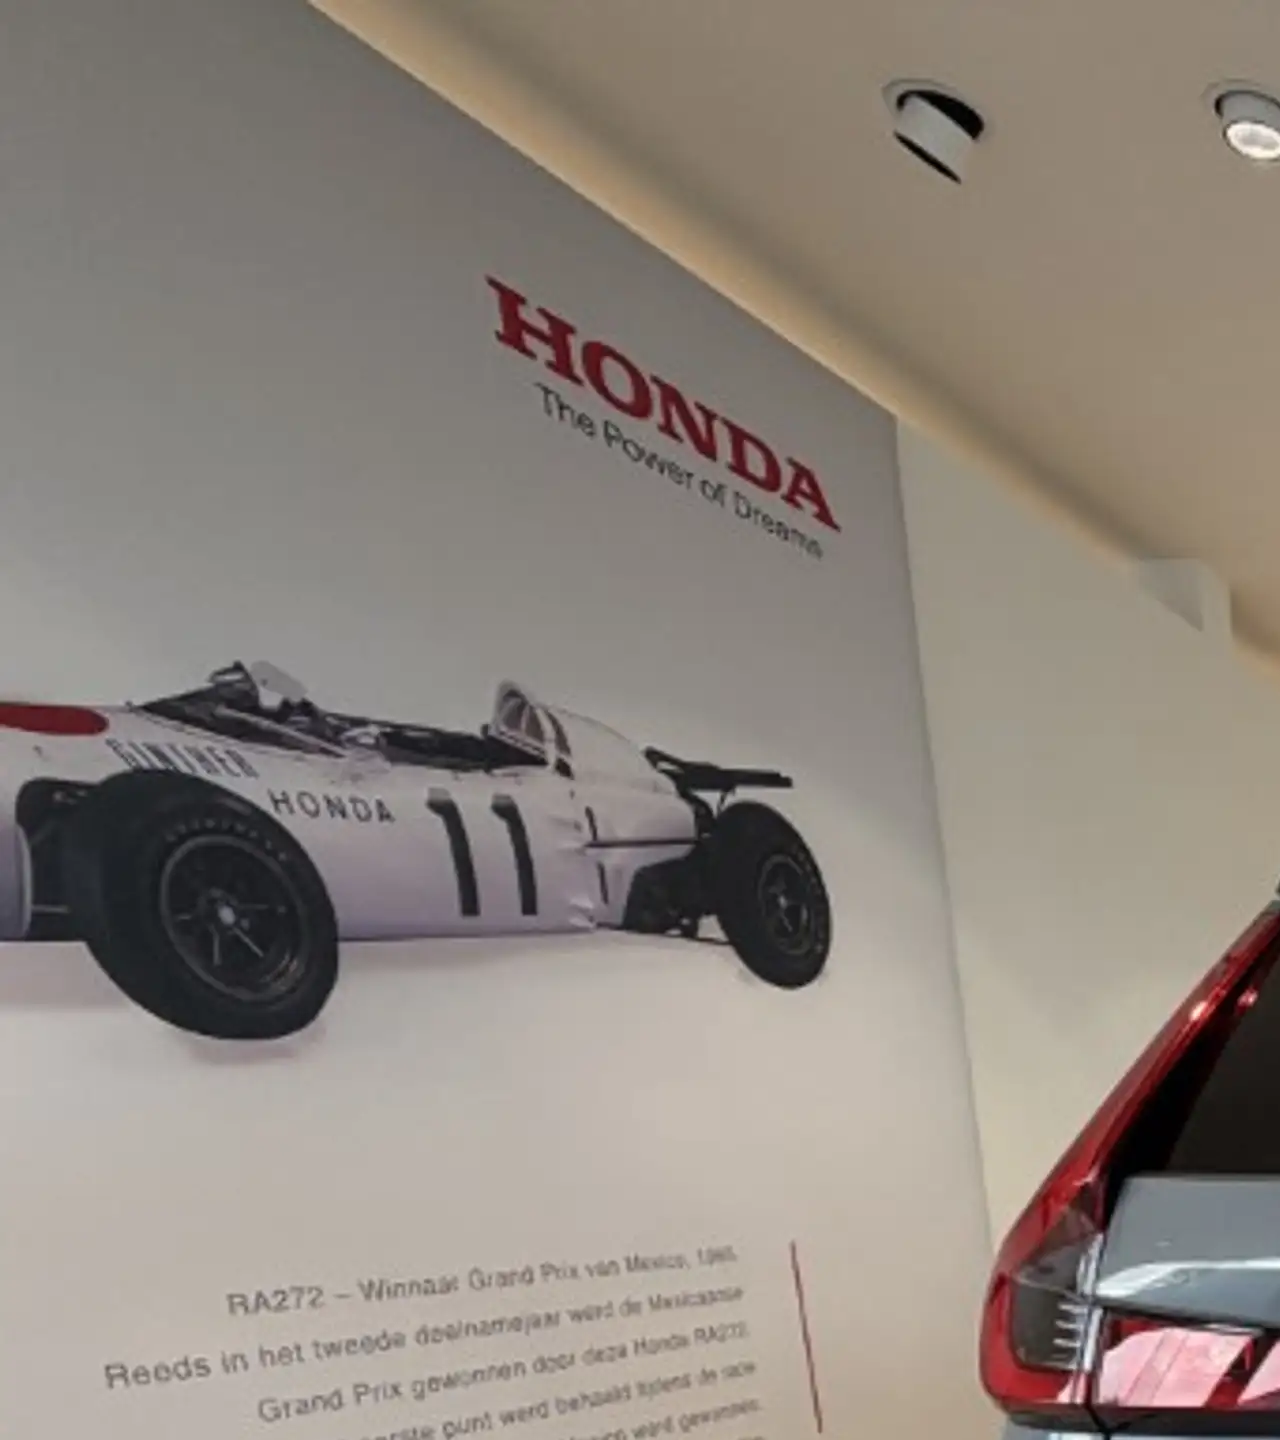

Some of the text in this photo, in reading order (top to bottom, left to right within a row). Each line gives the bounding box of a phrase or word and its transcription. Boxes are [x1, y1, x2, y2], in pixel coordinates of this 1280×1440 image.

[485, 274, 842, 533] HONDA
[534, 381, 824, 561] The Power of Dreams
[267, 787, 397, 823] HONDA
[427, 787, 538, 917] 11
[226, 1285, 325, 1316] RA272
[357, 1275, 460, 1303] Winnaar
[468, 1265, 535, 1291] Grand
[539, 1261, 579, 1281] Prix
[584, 1259, 621, 1278] van
[104, 1356, 212, 1390] Reeds
[220, 1351, 250, 1375] in
[257, 1345, 305, 1369] het
[313, 1328, 407, 1361] tweede
[567, 1300, 614, 1324] werd
[619, 1295, 643, 1318] de
[257, 1389, 345, 1423] Grand
[352, 1380, 403, 1406] Prix
[411, 1359, 527, 1402] gewonnen
[531, 1351, 576, 1376] door
[632, 1333, 691, 1356] Honda
[499, 1400, 550, 1427] werd
[555, 1384, 632, 1415] behaald
[698, 1366, 718, 1387] de
[630, 1415, 674, 1440] werd
